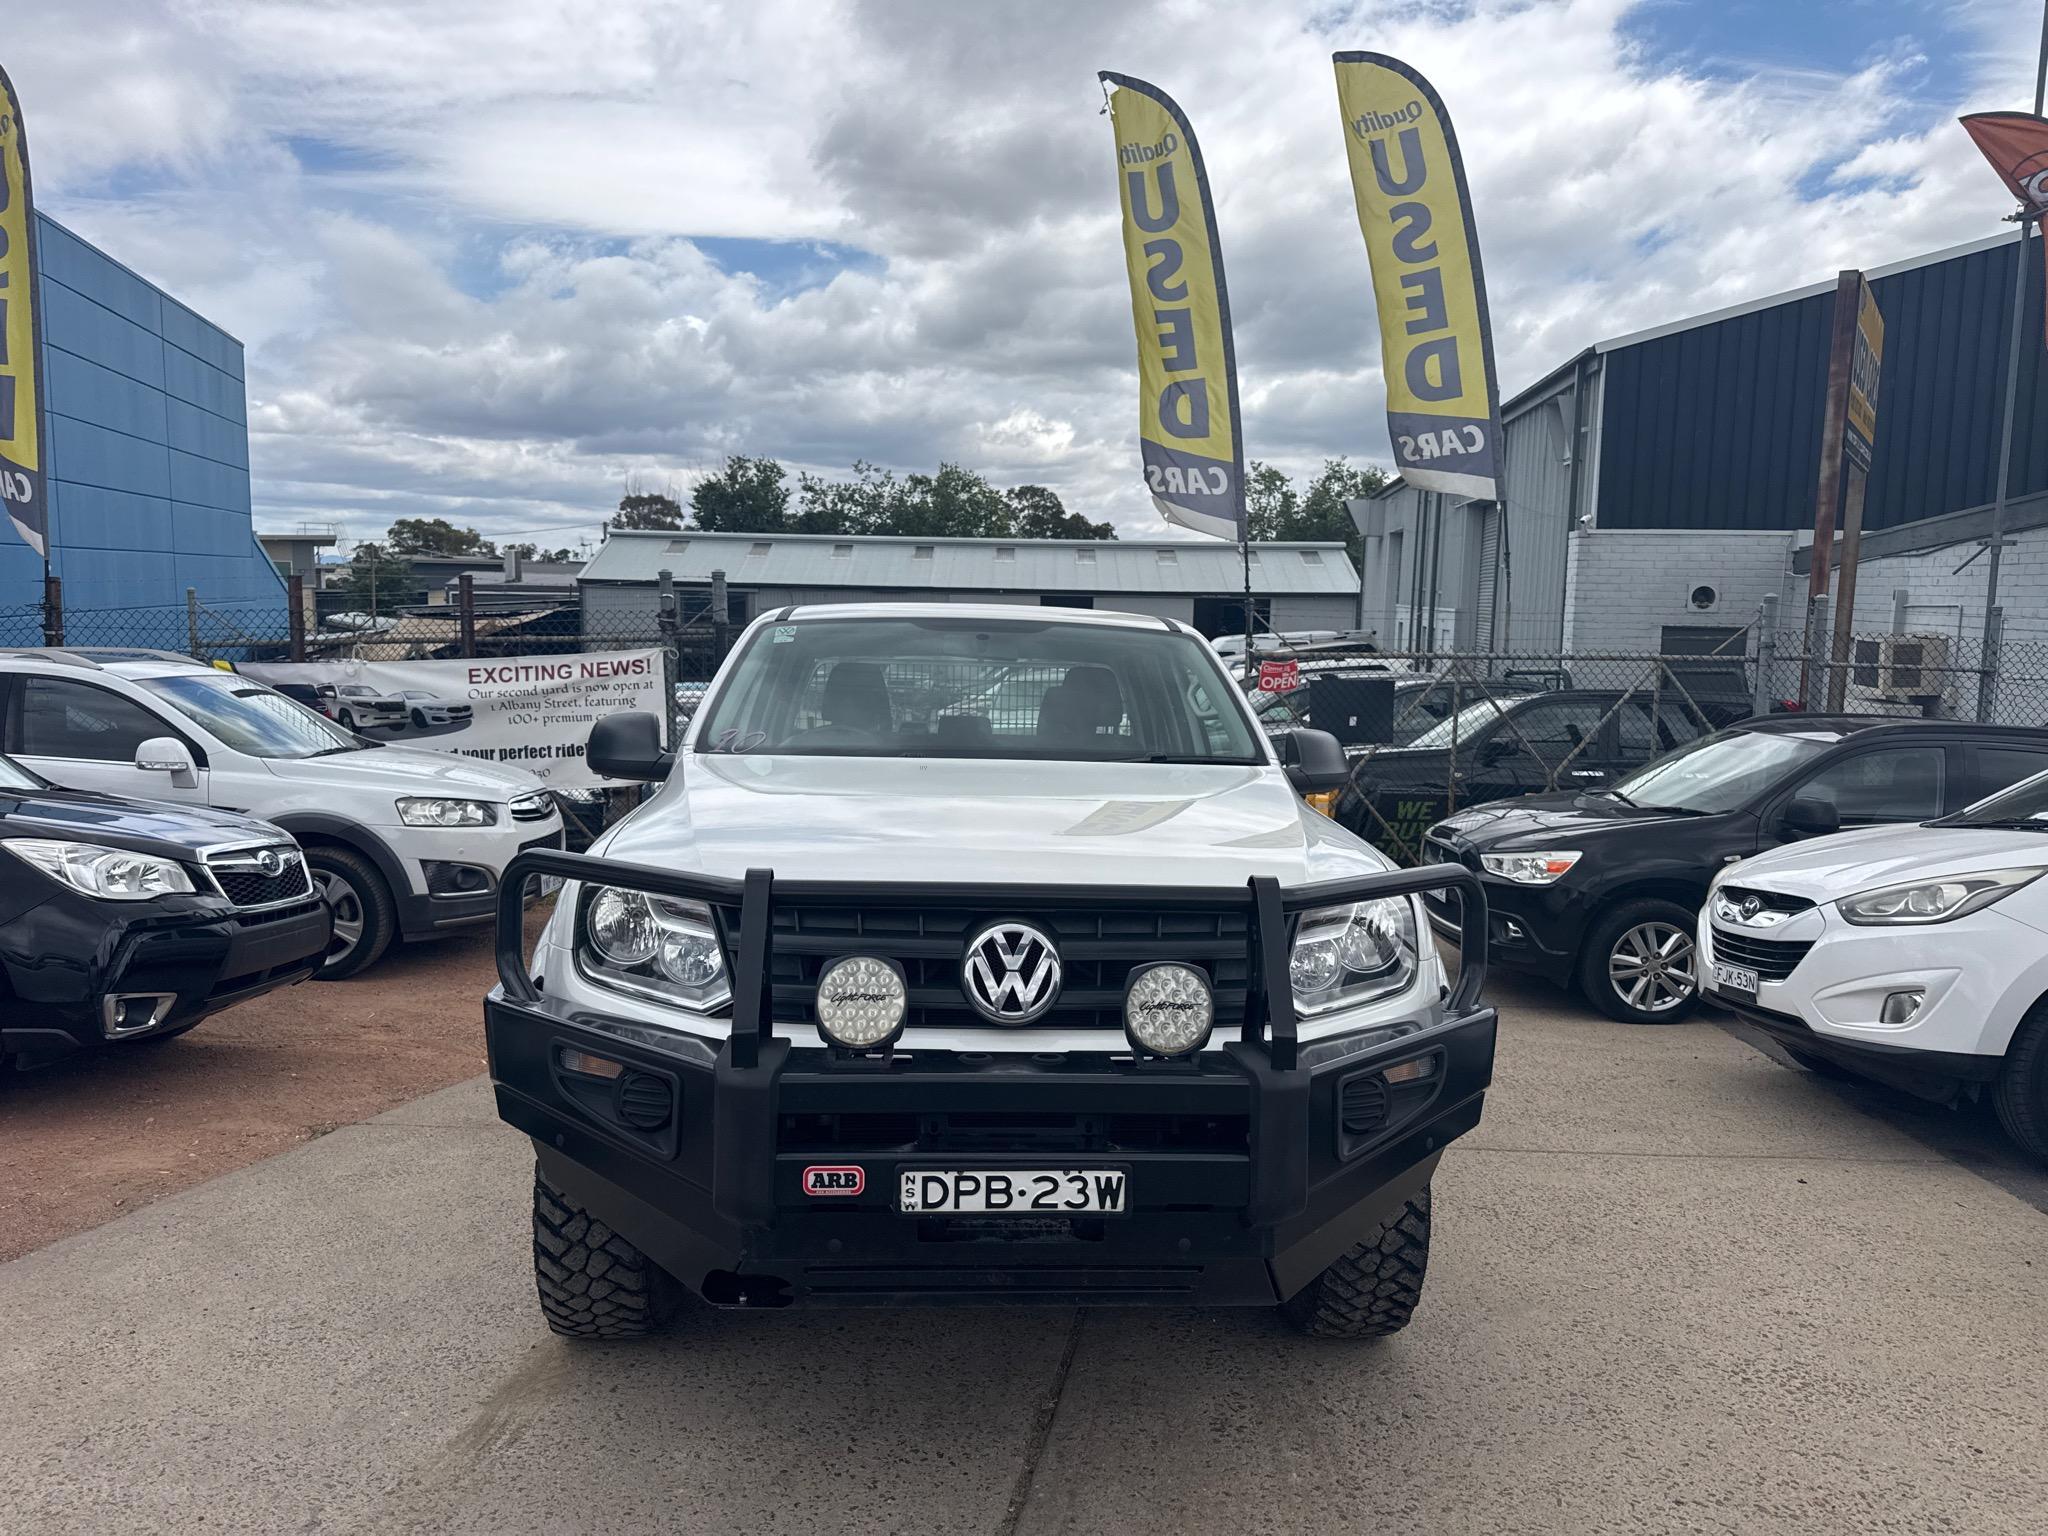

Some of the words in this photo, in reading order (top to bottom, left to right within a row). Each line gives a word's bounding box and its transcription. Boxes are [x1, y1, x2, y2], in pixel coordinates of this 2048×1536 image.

[468, 664, 573, 684] EXCITING
[580, 658, 651, 678] NEWS!
[468, 688, 494, 699] Our
[497, 685, 538, 698] second
[541, 683, 569, 698] yard
[572, 683, 581, 693] is
[585, 684, 610, 693] now
[613, 681, 641, 694] open
[643, 681, 654, 690] at
[1261, 675, 1297, 689] OPEN
[499, 700, 541, 712] Albany
[585, 694, 637, 708] featuring
[508, 713, 539, 725] 100+
[542, 711, 593, 727] premium
[499, 744, 552, 761] perfect
[1397, 801, 1437, 819] WE
[1374, 841, 1421, 860] AR
[811, 1173, 858, 1188] ARB
